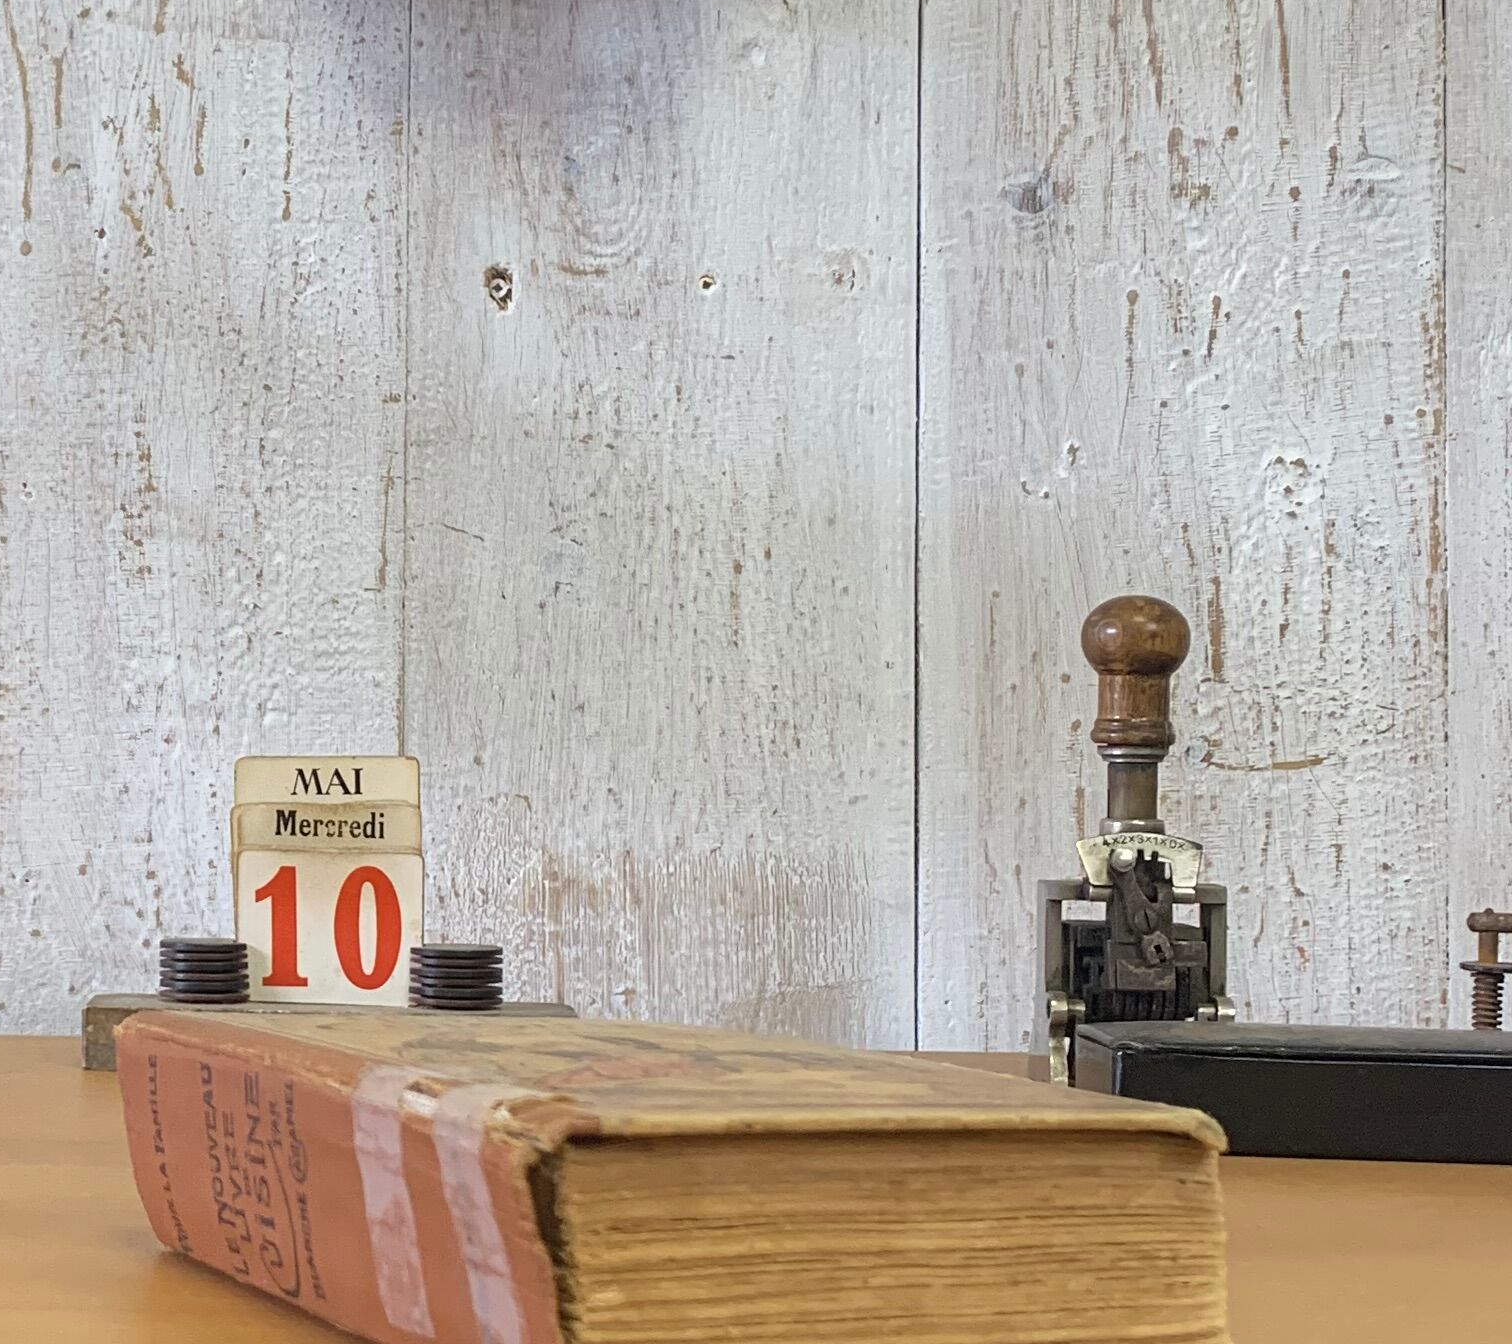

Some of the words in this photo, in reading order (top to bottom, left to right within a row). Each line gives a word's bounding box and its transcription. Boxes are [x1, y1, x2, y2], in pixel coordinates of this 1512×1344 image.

[290, 767, 364, 796] MAI
[274, 808, 385, 840] Mercredi
[254, 864, 403, 991] 10
[199, 1060, 237, 1229] NOUVEAU
